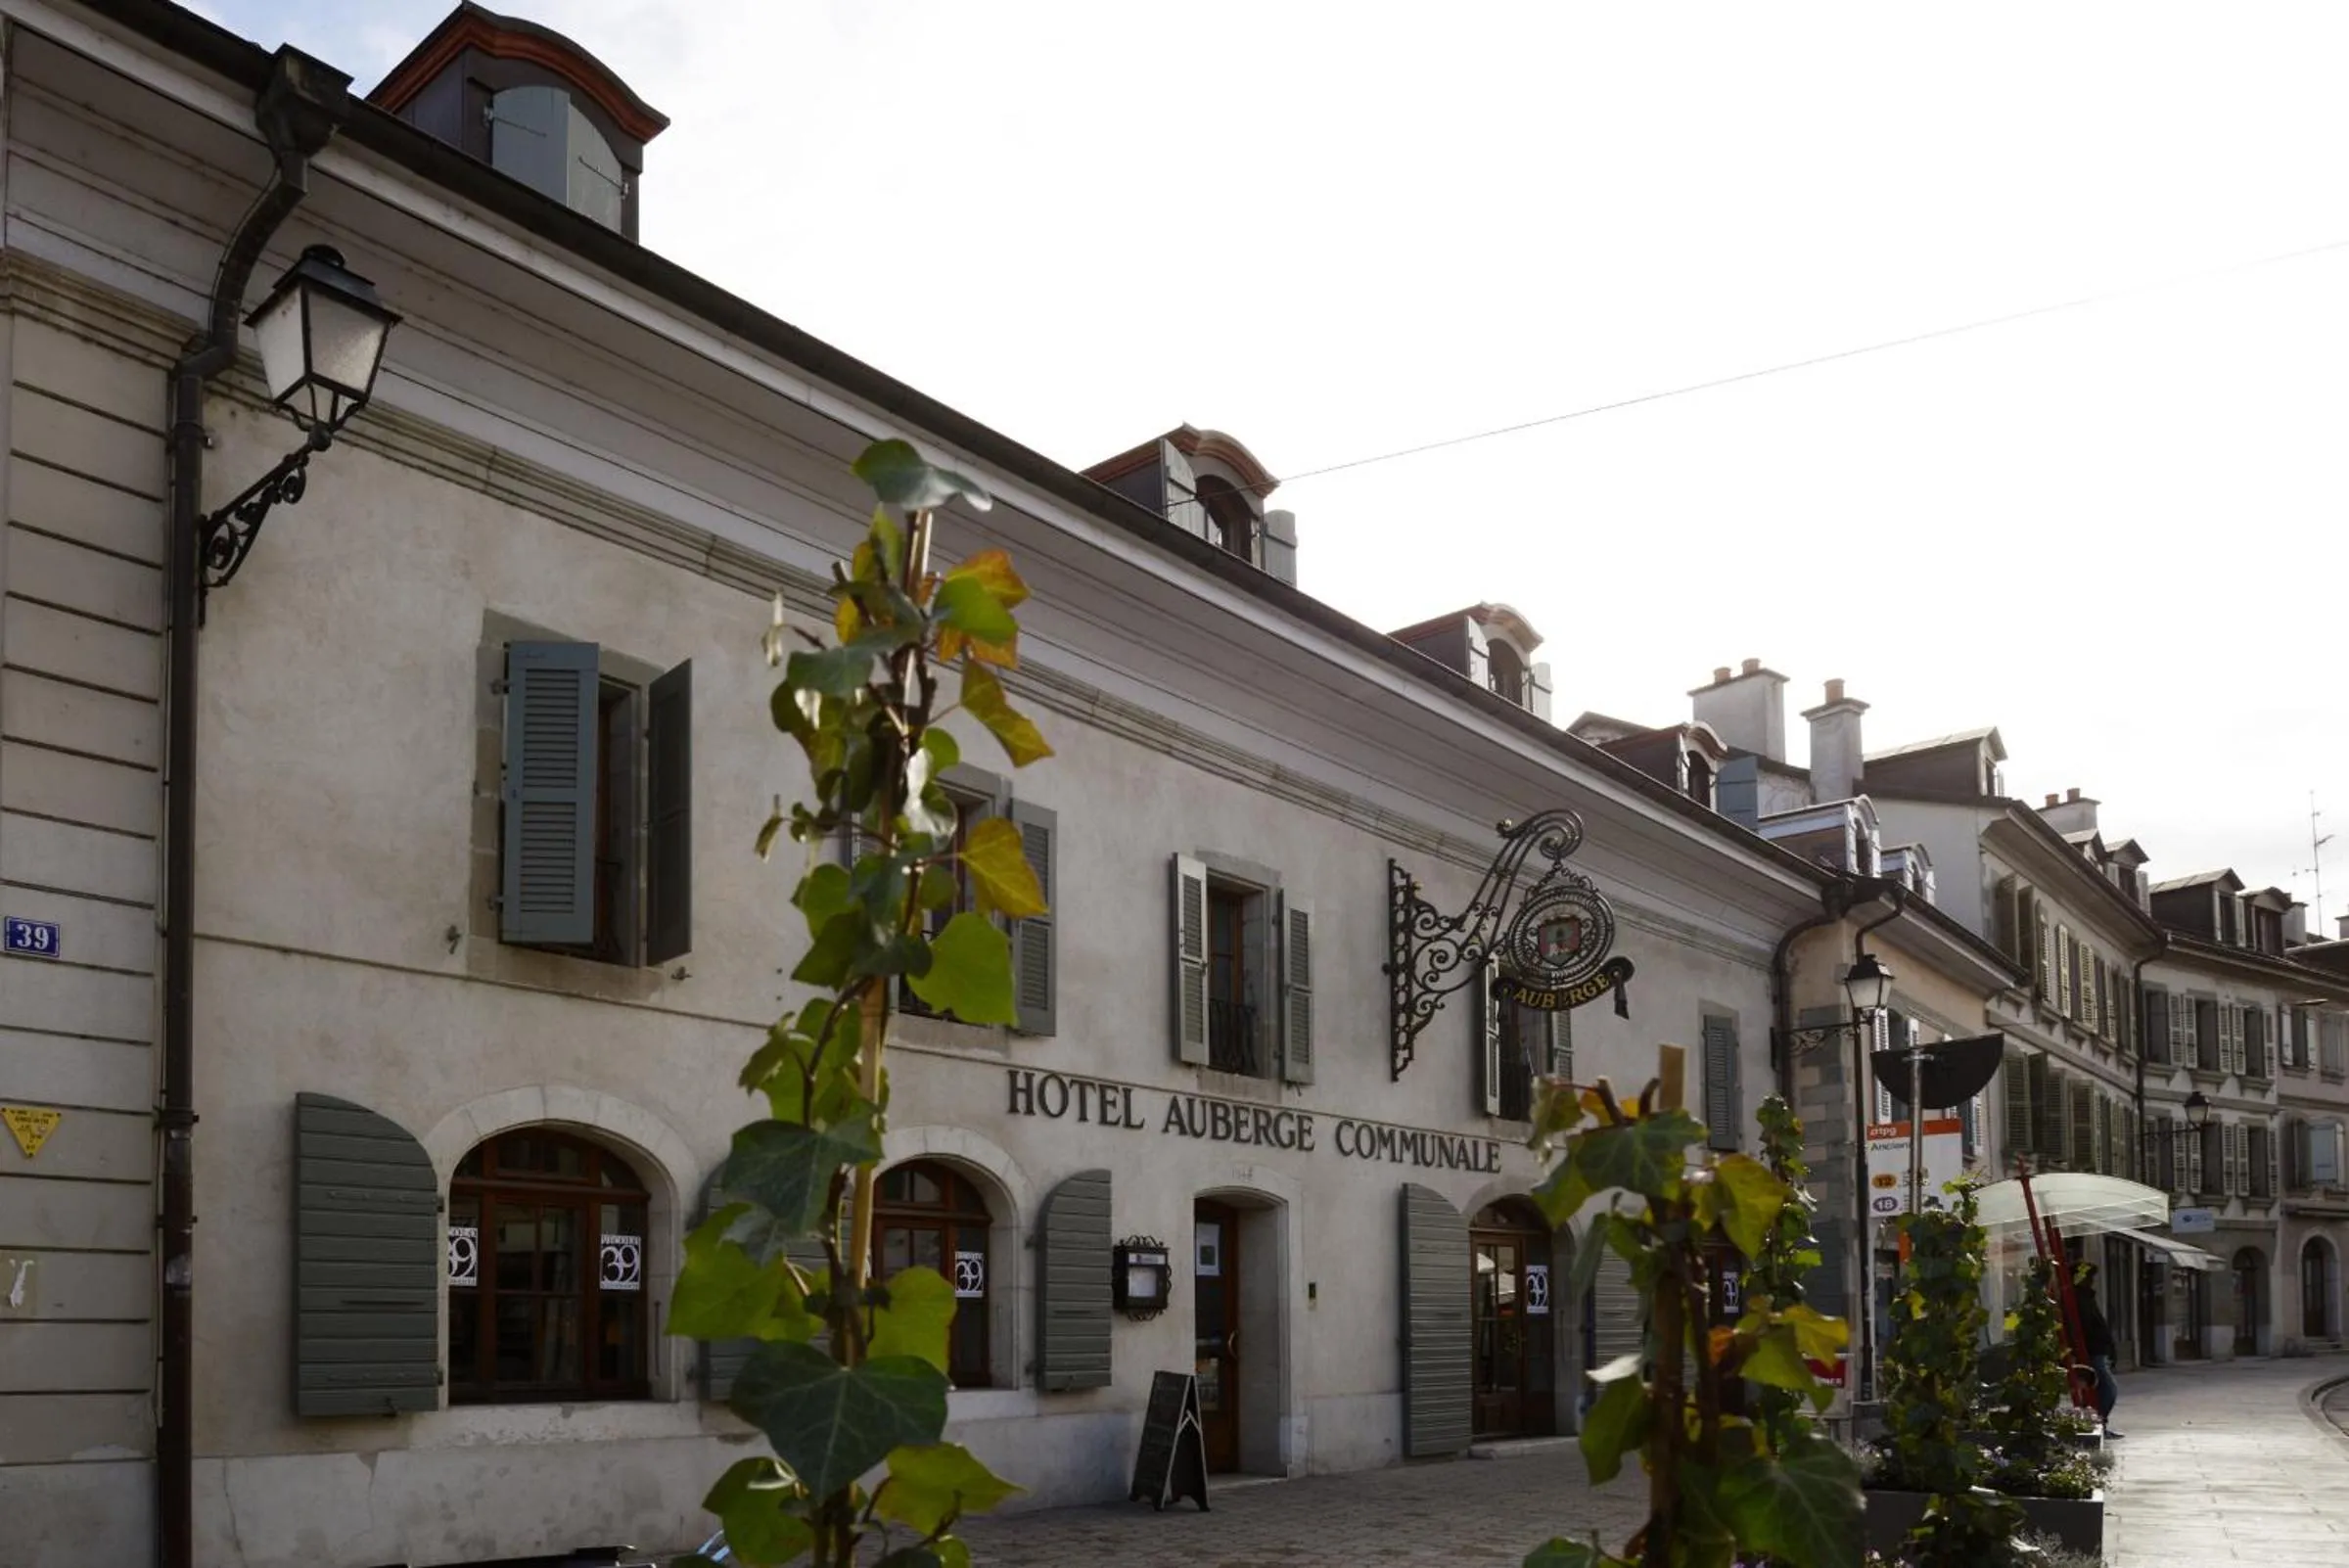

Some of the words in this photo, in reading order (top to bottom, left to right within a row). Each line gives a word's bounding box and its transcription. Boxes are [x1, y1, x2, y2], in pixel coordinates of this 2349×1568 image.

[17, 923, 49, 949] 39
[1007, 1069, 1144, 1130] HOTEL
[1162, 1095, 1315, 1152] AUBERGE
[1335, 1119, 1502, 1174] COMMUNALE
[1878, 1176, 1893, 1186] 12
[1877, 1199, 1895, 1210] 18
[601, 1244, 639, 1283] 39
[955, 1260, 983, 1292] 39
[1527, 1273, 1548, 1307] 39
